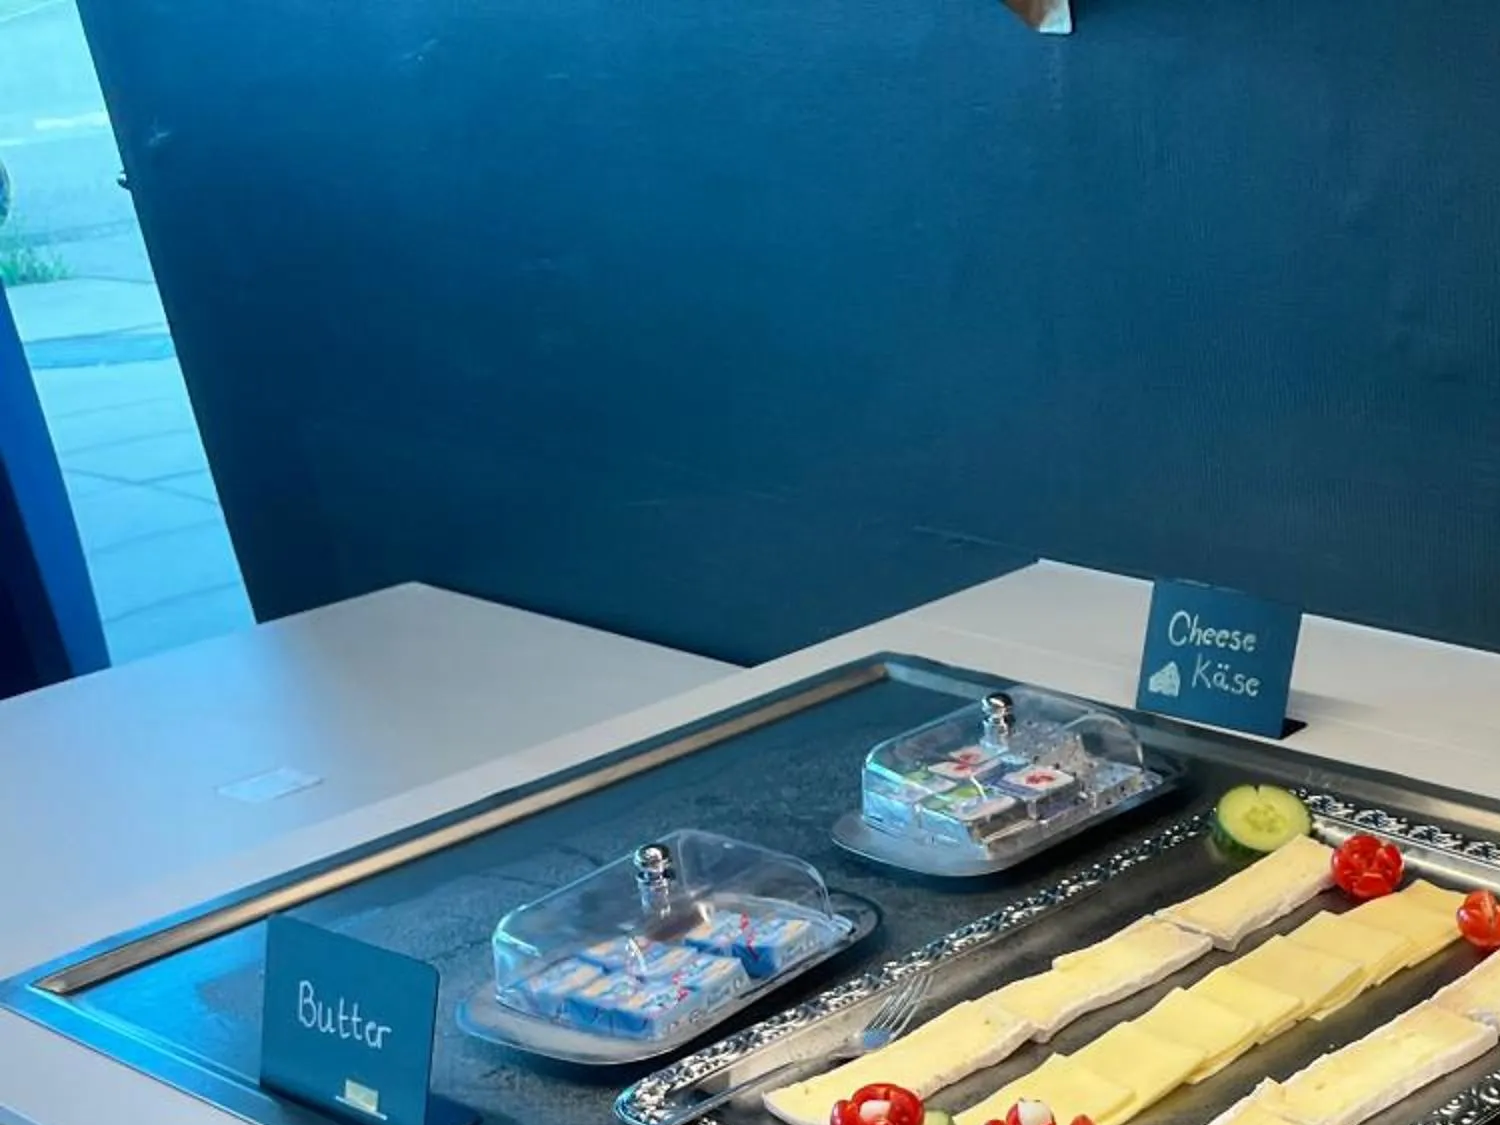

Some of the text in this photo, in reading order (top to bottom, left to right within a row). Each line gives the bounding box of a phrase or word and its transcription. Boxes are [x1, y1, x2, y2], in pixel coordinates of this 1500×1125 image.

[1168, 610, 1257, 652] Cheese
[1191, 653, 1261, 697] Käse
[298, 979, 393, 1049] Butter
